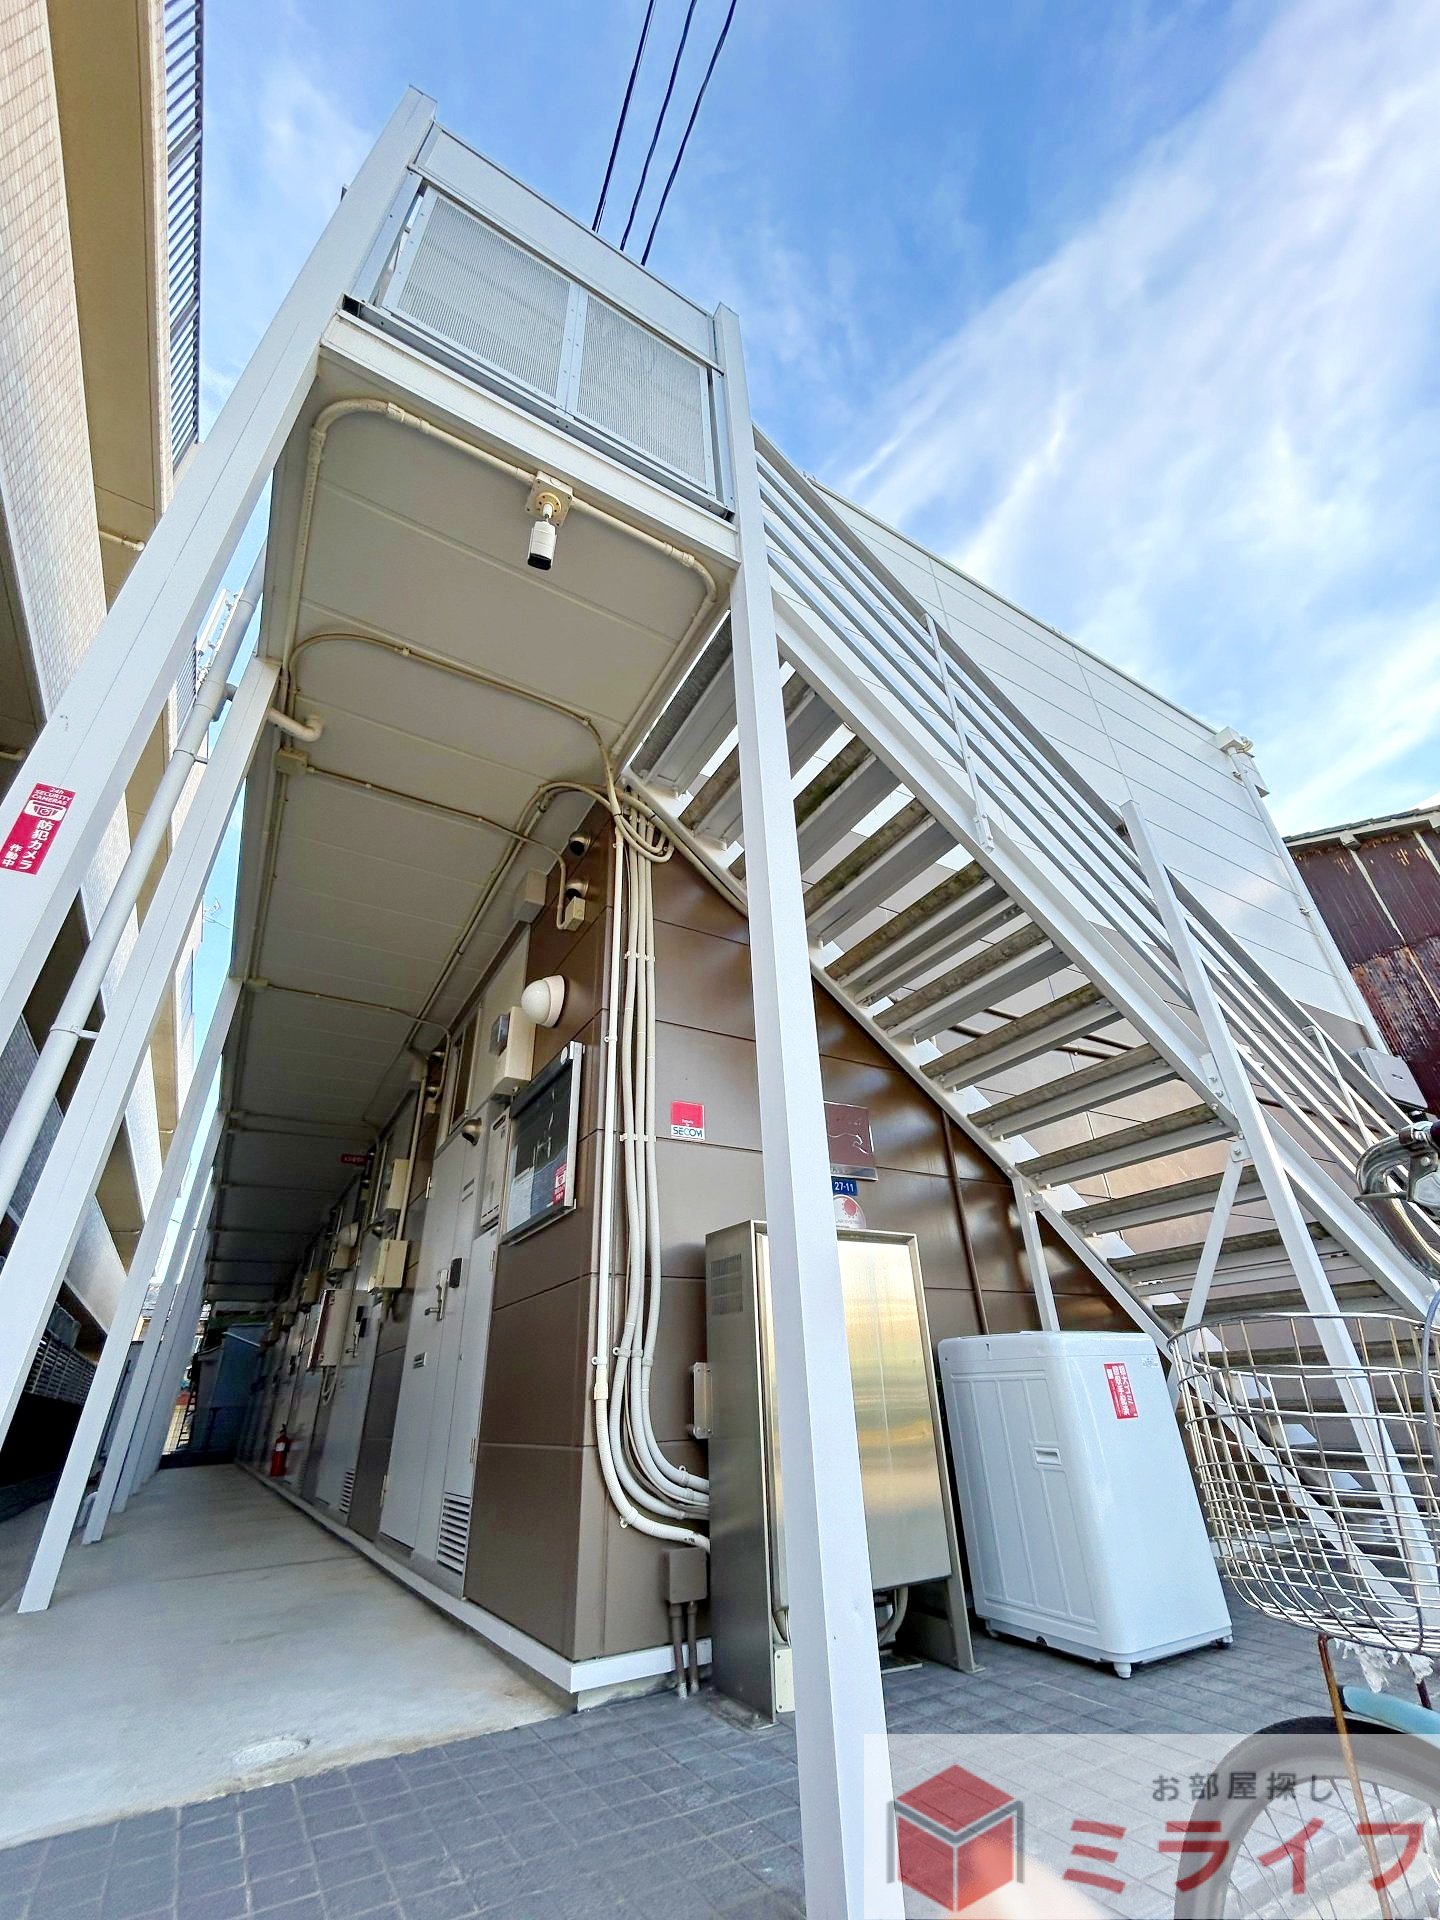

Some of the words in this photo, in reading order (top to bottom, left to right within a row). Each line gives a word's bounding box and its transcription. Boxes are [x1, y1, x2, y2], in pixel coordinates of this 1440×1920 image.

[31, 793, 68, 806] CAMERAS
[33, 789, 73, 802] SECURITY
[19, 819, 55, 870] 防犯カメラ
[2, 843, 23, 867] 作動中
[673, 1126, 703, 1138] SECOM
[834, 1181, 854, 1192] 27-11
